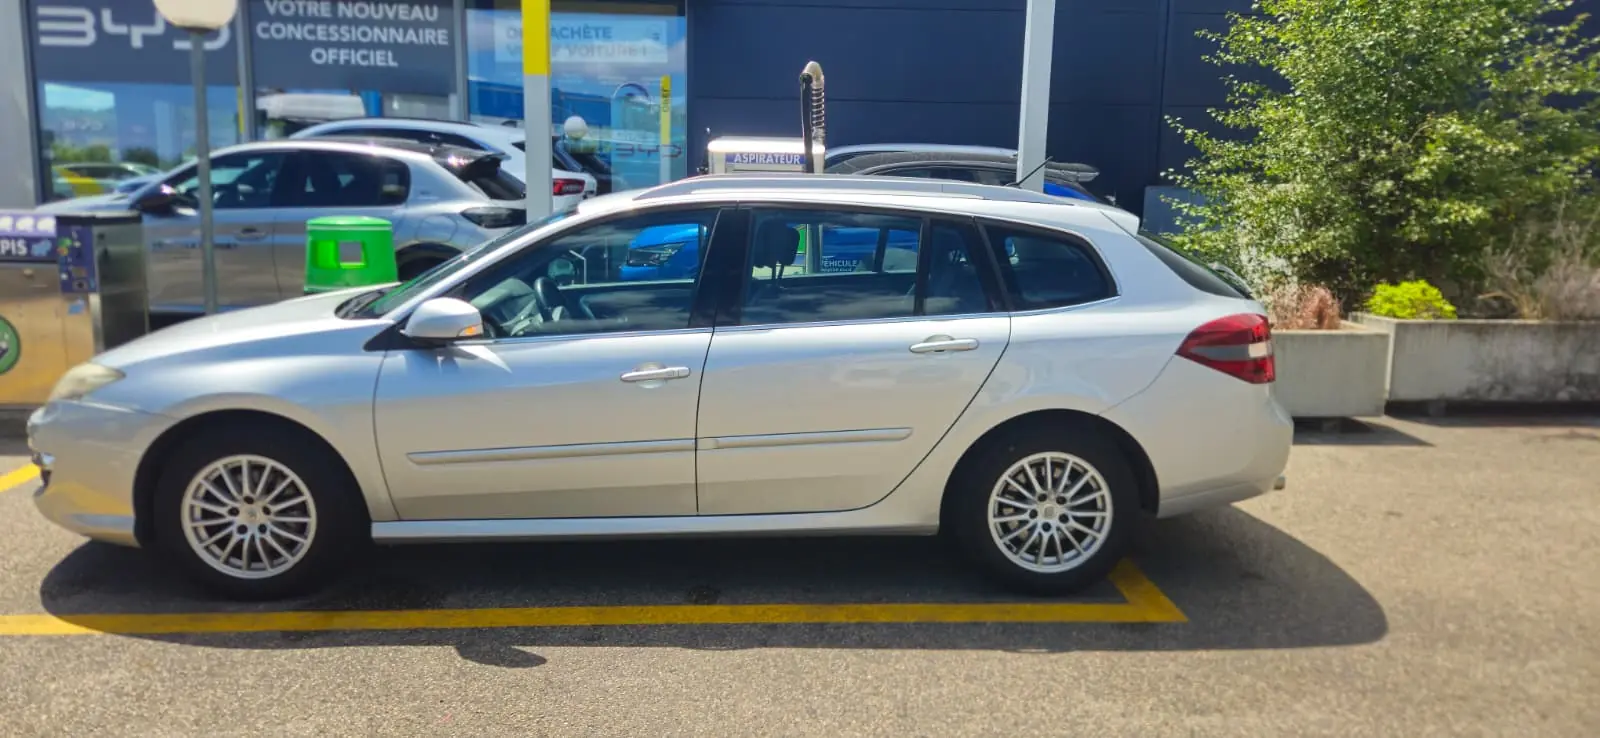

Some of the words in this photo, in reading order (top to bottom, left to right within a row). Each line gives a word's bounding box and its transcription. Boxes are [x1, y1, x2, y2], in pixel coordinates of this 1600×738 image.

[264, 0, 332, 17] VOTRE
[338, 1, 439, 21] NOUVEAU
[256, 22, 449, 45] CONCESSIONNAIRE
[550, 23, 613, 40] ACHÈTE
[310, 48, 398, 67] OFFICIEL
[734, 153, 801, 164] ASPIRATEUR
